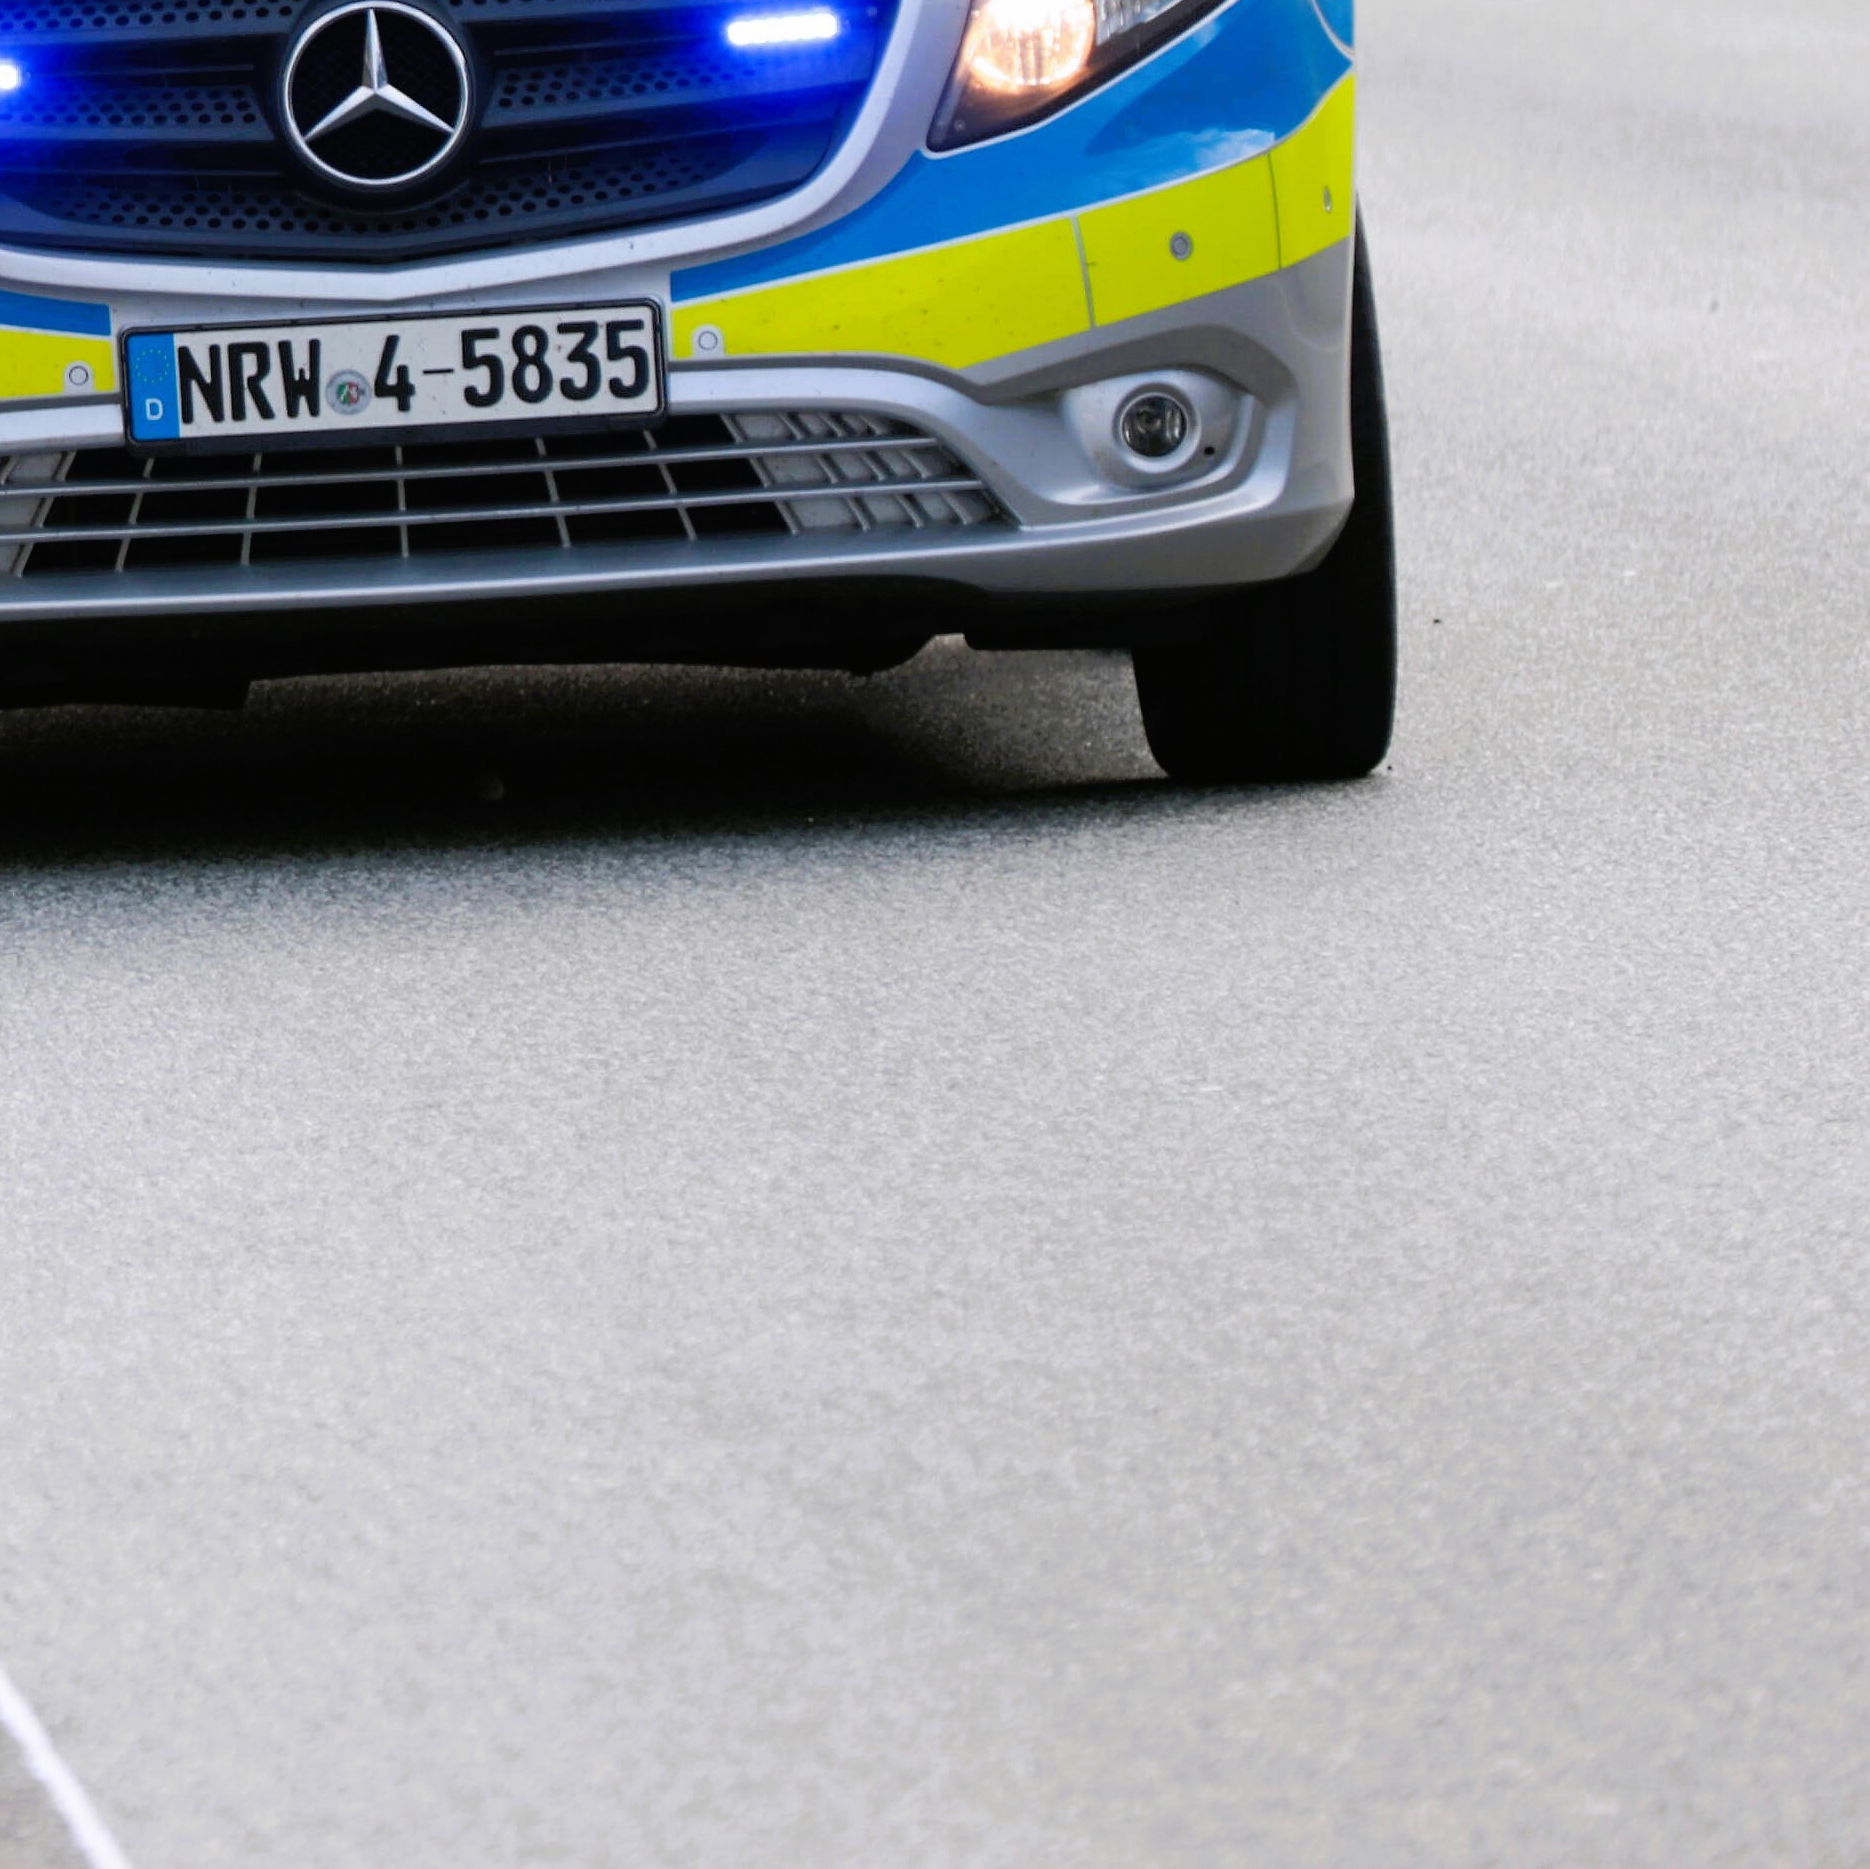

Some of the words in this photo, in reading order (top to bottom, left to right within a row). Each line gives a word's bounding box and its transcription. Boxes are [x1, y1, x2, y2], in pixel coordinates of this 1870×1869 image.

[177, 338, 321, 424] NRW
[374, 319, 650, 413] 4-5835
[145, 398, 164, 421] D
